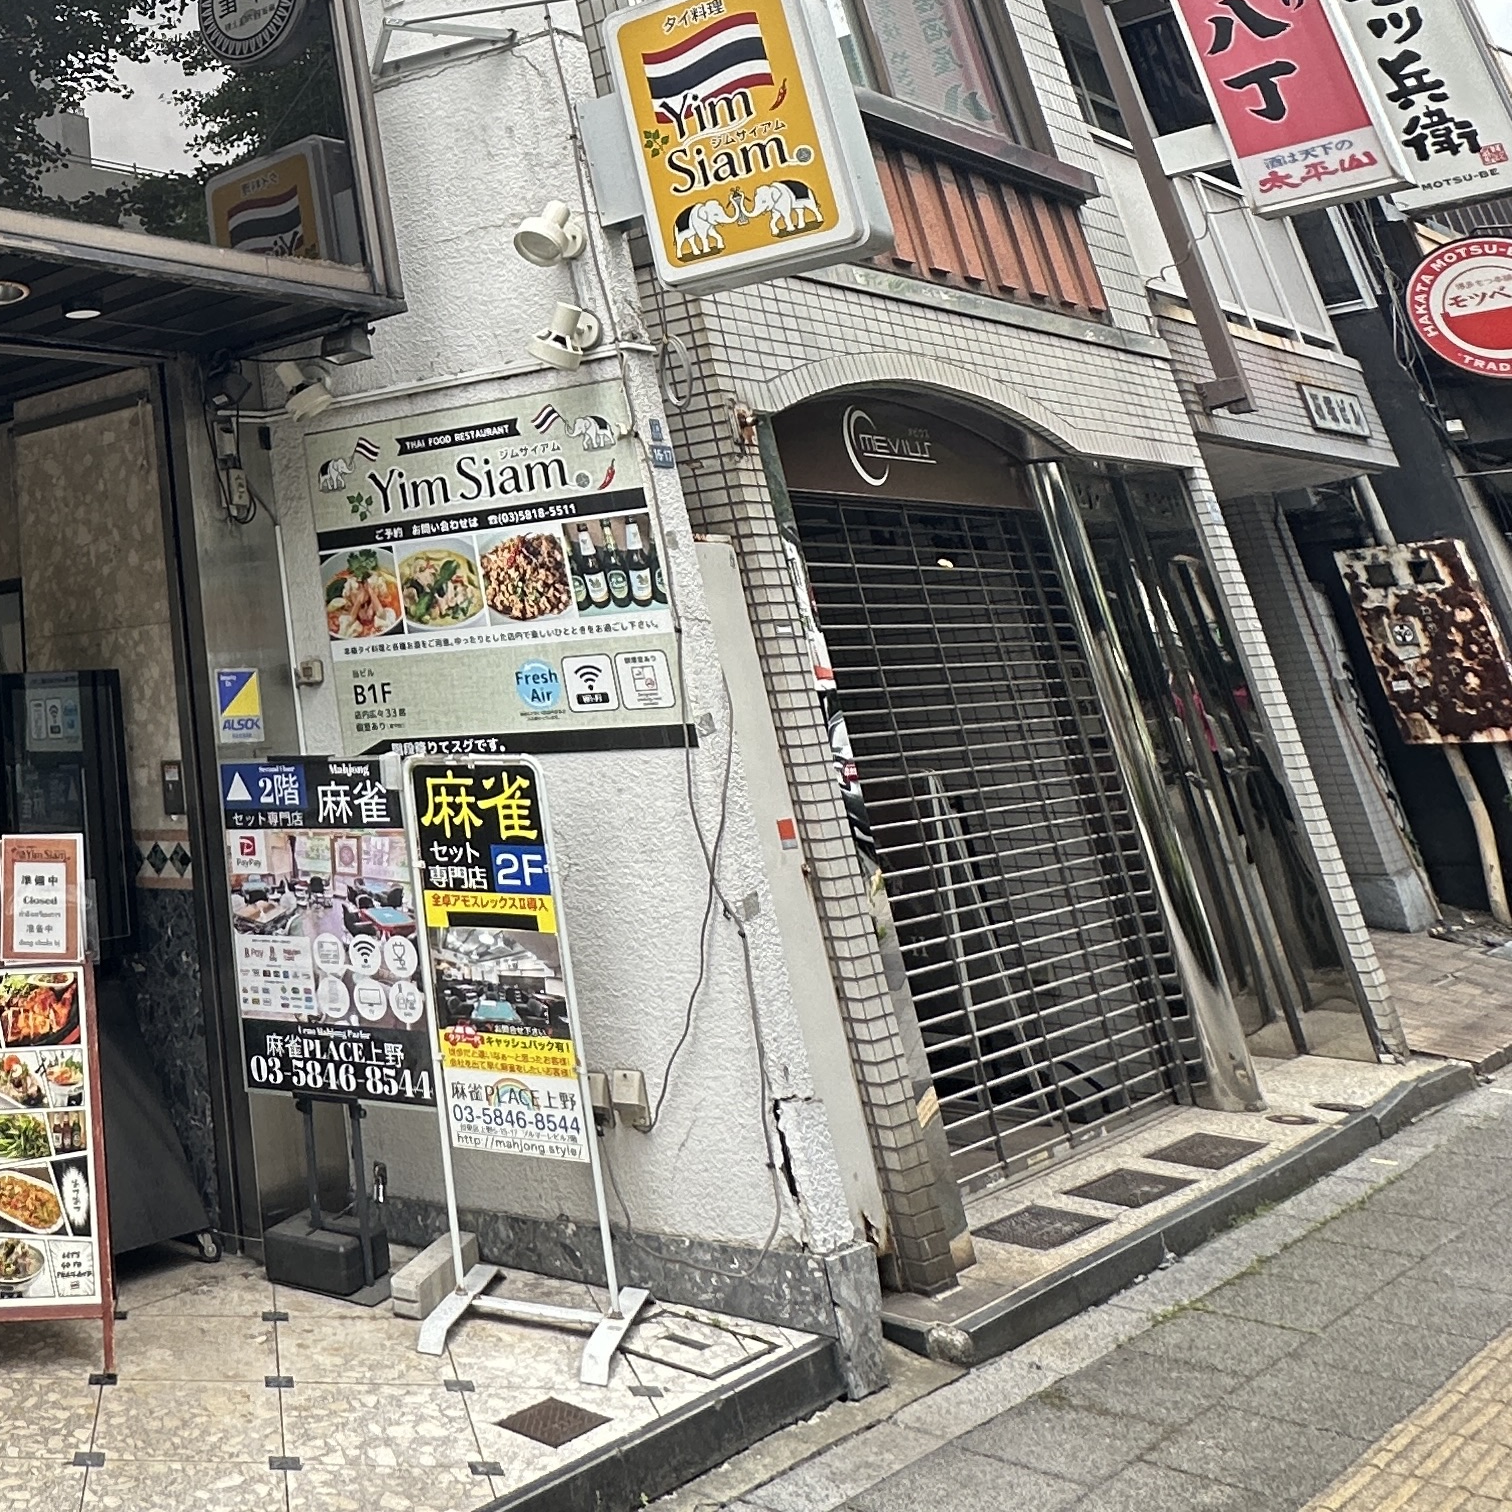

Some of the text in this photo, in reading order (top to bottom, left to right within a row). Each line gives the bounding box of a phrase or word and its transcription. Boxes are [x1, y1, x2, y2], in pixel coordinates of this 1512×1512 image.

[659, 90, 754, 140] Yim
[668, 134, 788, 195] Siam
[1264, 138, 1355, 171] 酒は天下の
[1259, 151, 1379, 194] 太平山
[1422, 168, 1500, 191] MOTSU-BE
[1414, 273, 1439, 338] HAKATA
[405, 424, 510, 450] THAI FOOD RESTAURANT
[368, 455, 570, 514] Yim Siam
[516, 668, 559, 686] Fresh
[353, 681, 393, 706] B1F
[531, 688, 554, 704] Air
[222, 718, 261, 731] ALSOK
[328, 763, 371, 778] Mahjong
[258, 773, 300, 807] 2階
[316, 779, 392, 825] 麻雀
[420, 768, 538, 841] 麻雀
[231, 811, 305, 828] セット専門店
[429, 840, 481, 864] セット
[428, 865, 488, 890] 専門店
[495, 852, 544, 887] 2F
[22, 896, 58, 906] Closed
[249, 1054, 435, 1100] 03-5846-8544
[452, 1103, 581, 1135] 03-5846-8544
